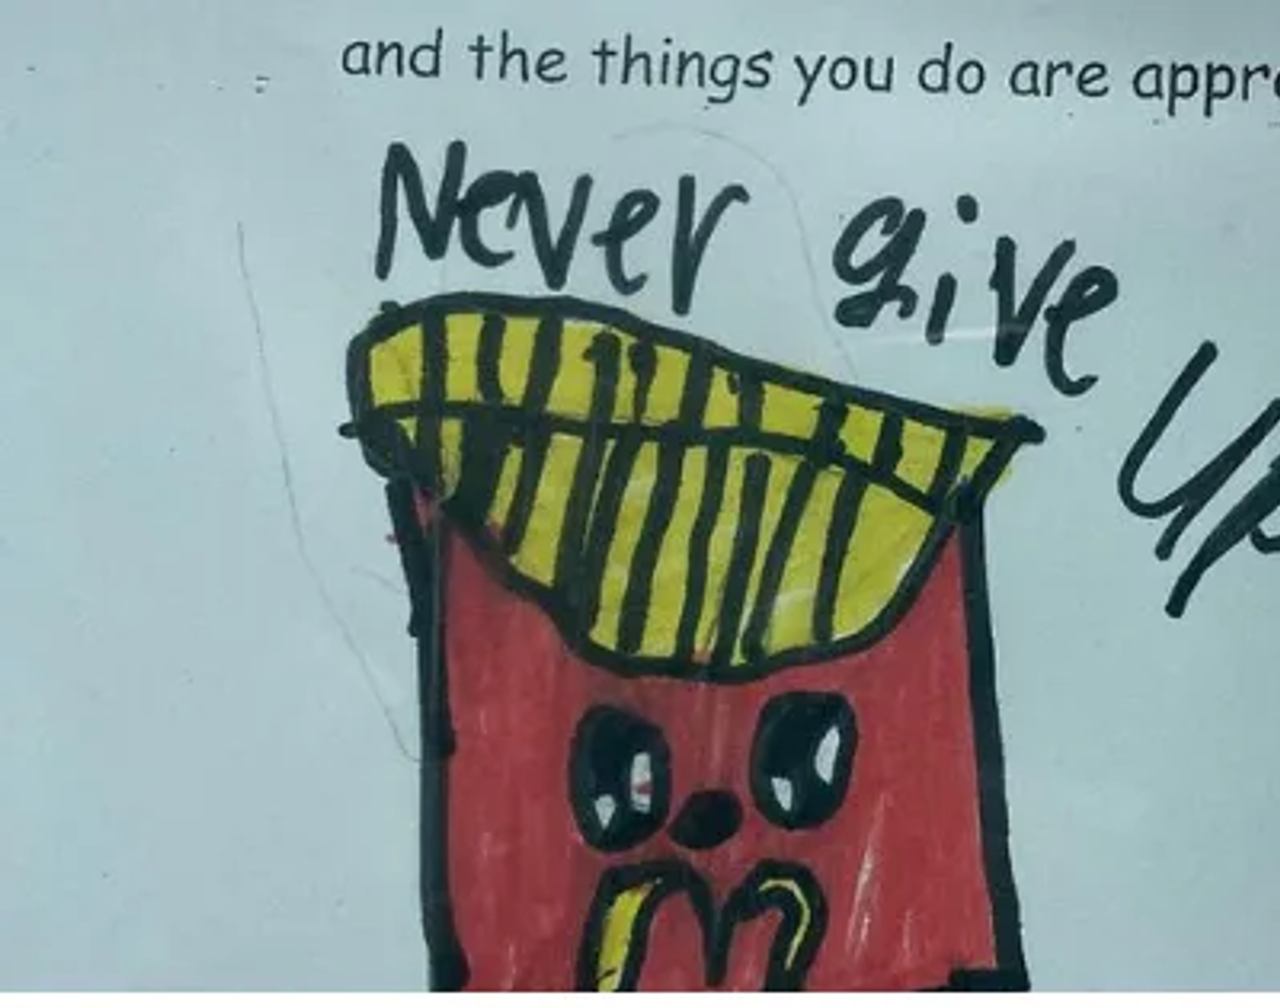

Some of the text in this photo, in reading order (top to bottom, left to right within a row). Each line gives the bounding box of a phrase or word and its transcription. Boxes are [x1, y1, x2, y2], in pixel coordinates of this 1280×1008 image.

[342, 28, 443, 78] and
[468, 30, 568, 84] the
[591, 34, 774, 104] things
[793, 56, 894, 107] you
[917, 42, 986, 95] do
[1009, 60, 1109, 98] are
[374, 140, 749, 316] Never
